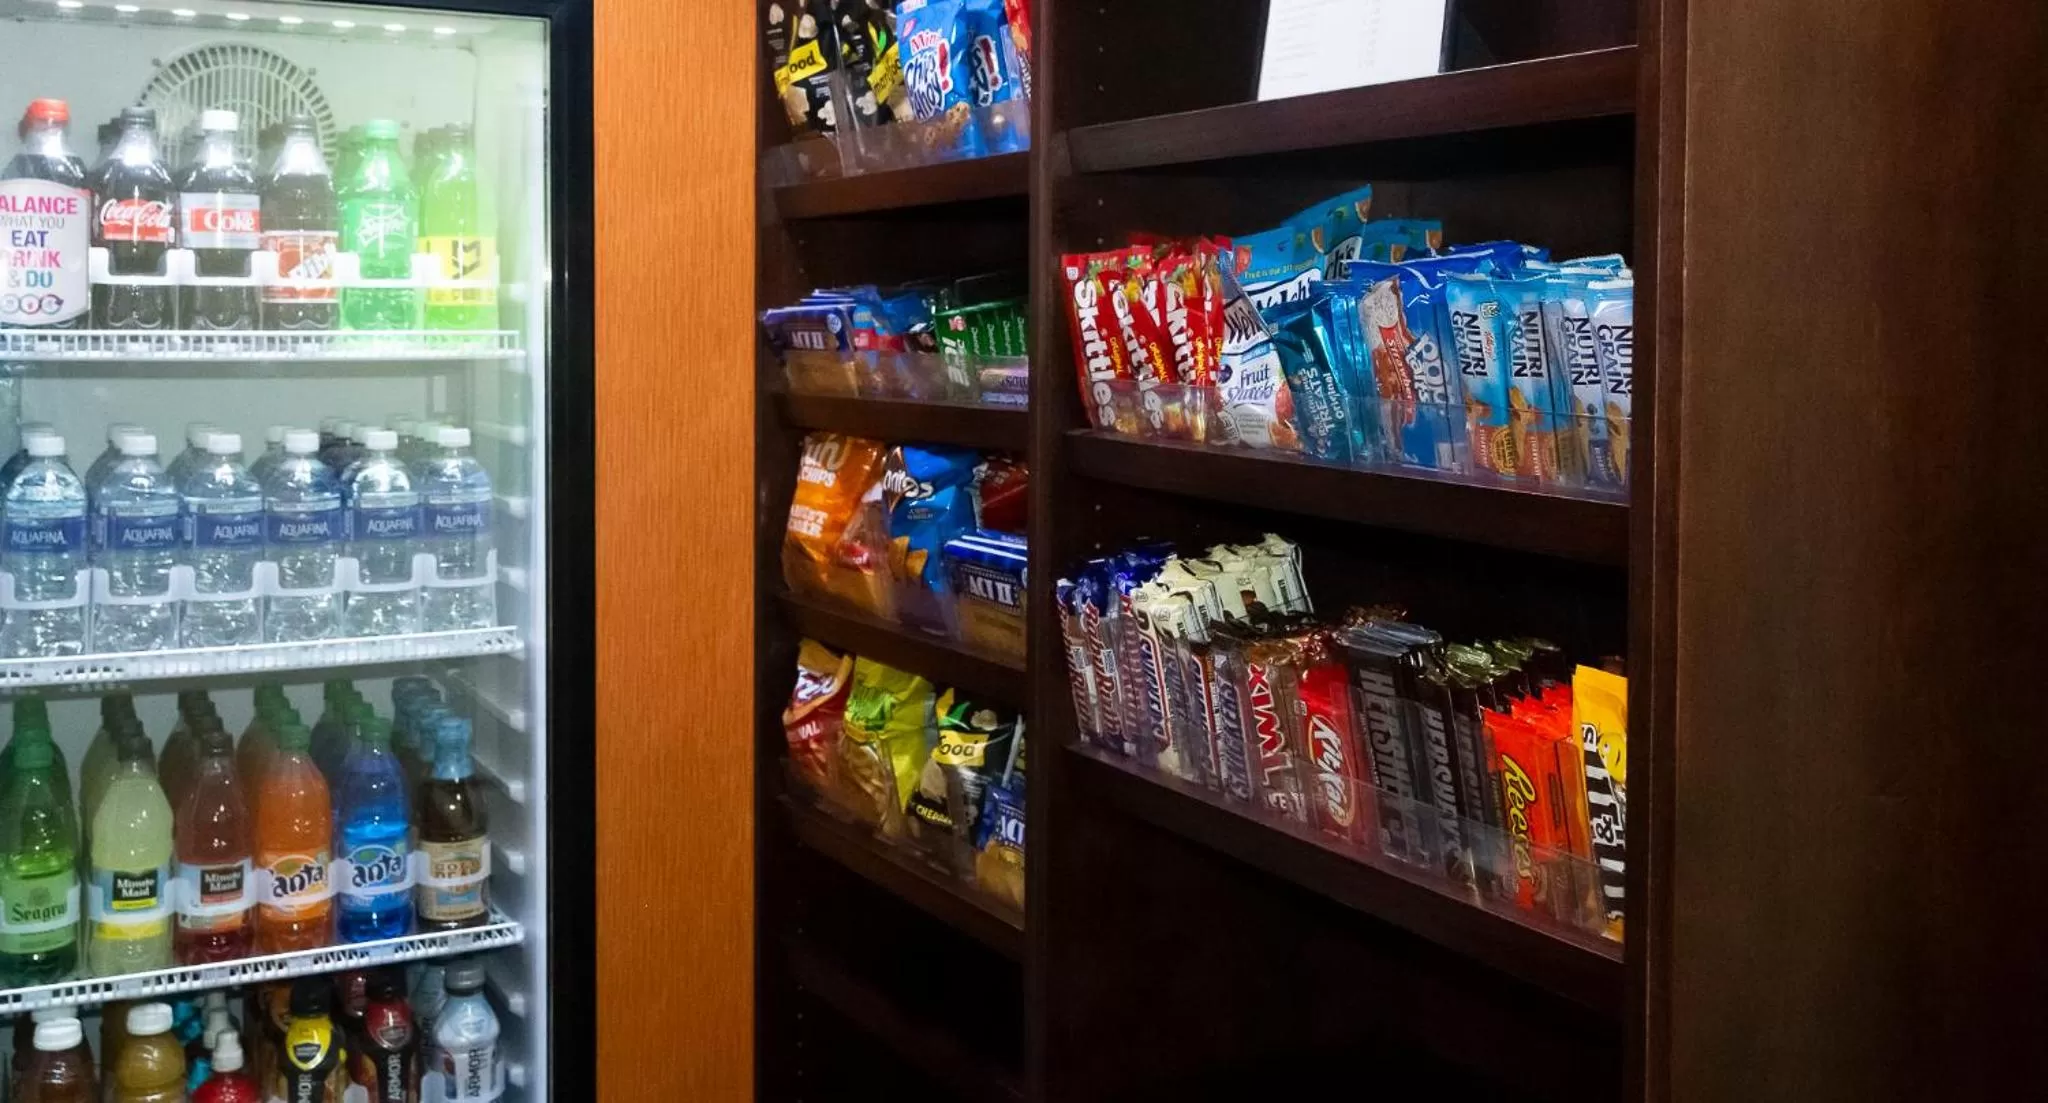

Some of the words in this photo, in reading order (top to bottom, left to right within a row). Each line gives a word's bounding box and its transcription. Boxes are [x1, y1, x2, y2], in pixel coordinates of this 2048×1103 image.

[789, 50, 816, 73] ood
[0, 195, 77, 215] ALANCE
[204, 210, 257, 232] Coke
[12, 230, 49, 248] EAT
[9, 250, 62, 269] RINK
[1073, 279, 1116, 427] Skittles
[1452, 310, 1475, 377] GRAIN
[1462, 313, 1488, 378] NUTRI
[1522, 312, 1545, 379] NUTRI
[1563, 315, 1588, 386] GRAIN
[1573, 317, 1602, 386] NUTRI
[1597, 324, 1627, 395] GRAIN
[213, 523, 261, 541] AQUAFINA
[278, 520, 331, 537] AQUAFINA
[367, 516, 416, 535] AQUAFINA
[434, 513, 485, 531] AQUAFINA
[9, 528, 67, 544] AQUAFINA
[122, 526, 174, 544] AQUAFINA
[203, 872, 242, 885] Minute
[270, 863, 324, 898] anta
[350, 854, 402, 888] anta
[116, 877, 155, 891] Minute
[121, 887, 150, 898] Maid
[209, 881, 239, 893] Maid
[11, 902, 68, 922] Seagra
[299, 1072, 312, 1103] MOR
